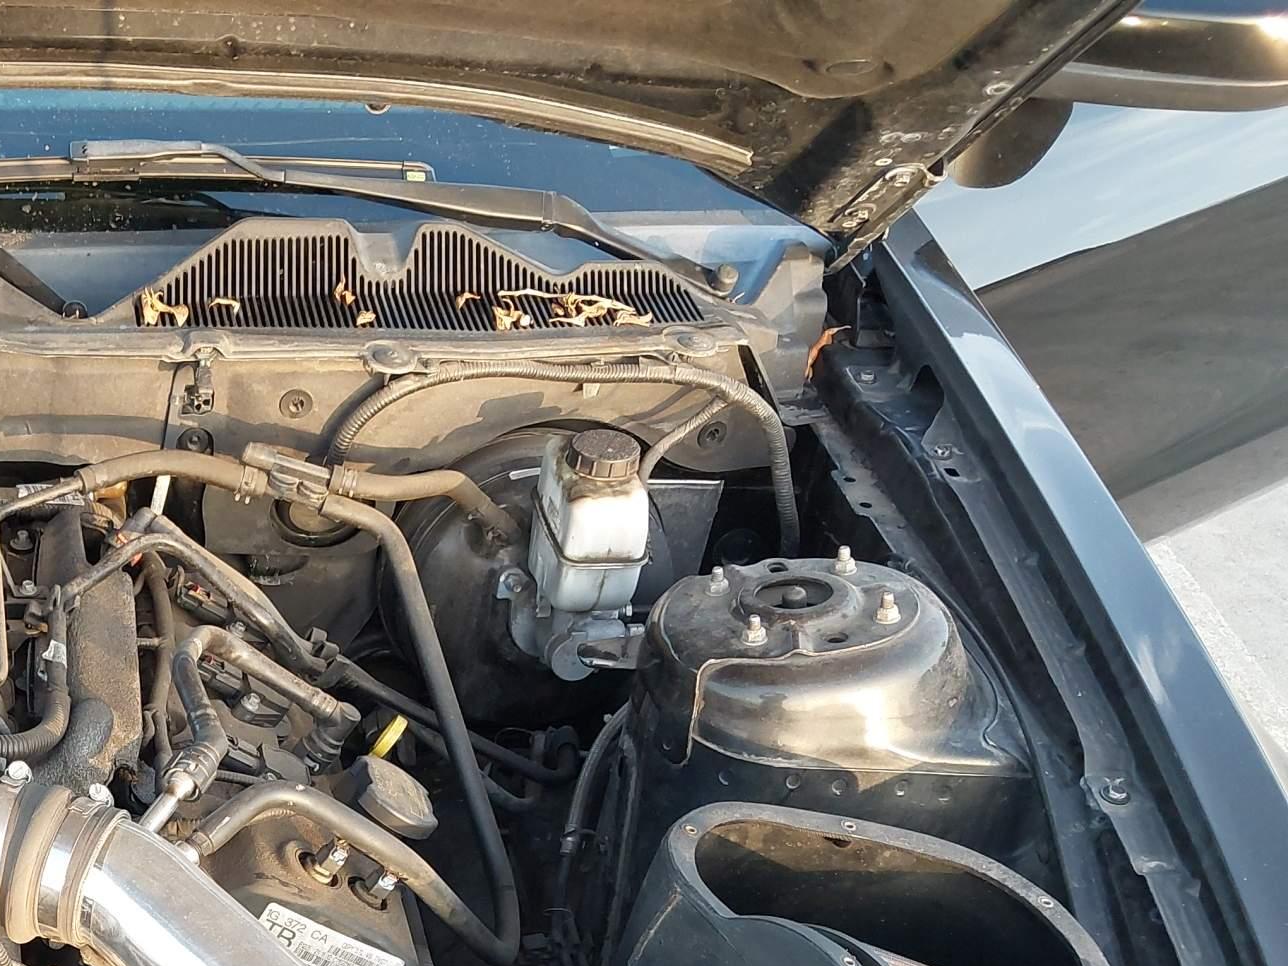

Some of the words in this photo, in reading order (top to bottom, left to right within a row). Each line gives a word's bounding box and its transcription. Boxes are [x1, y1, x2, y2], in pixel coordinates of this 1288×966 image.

[265, 908, 281, 922] 1G
[284, 917, 308, 936] 372
[310, 929, 329, 945] CA
